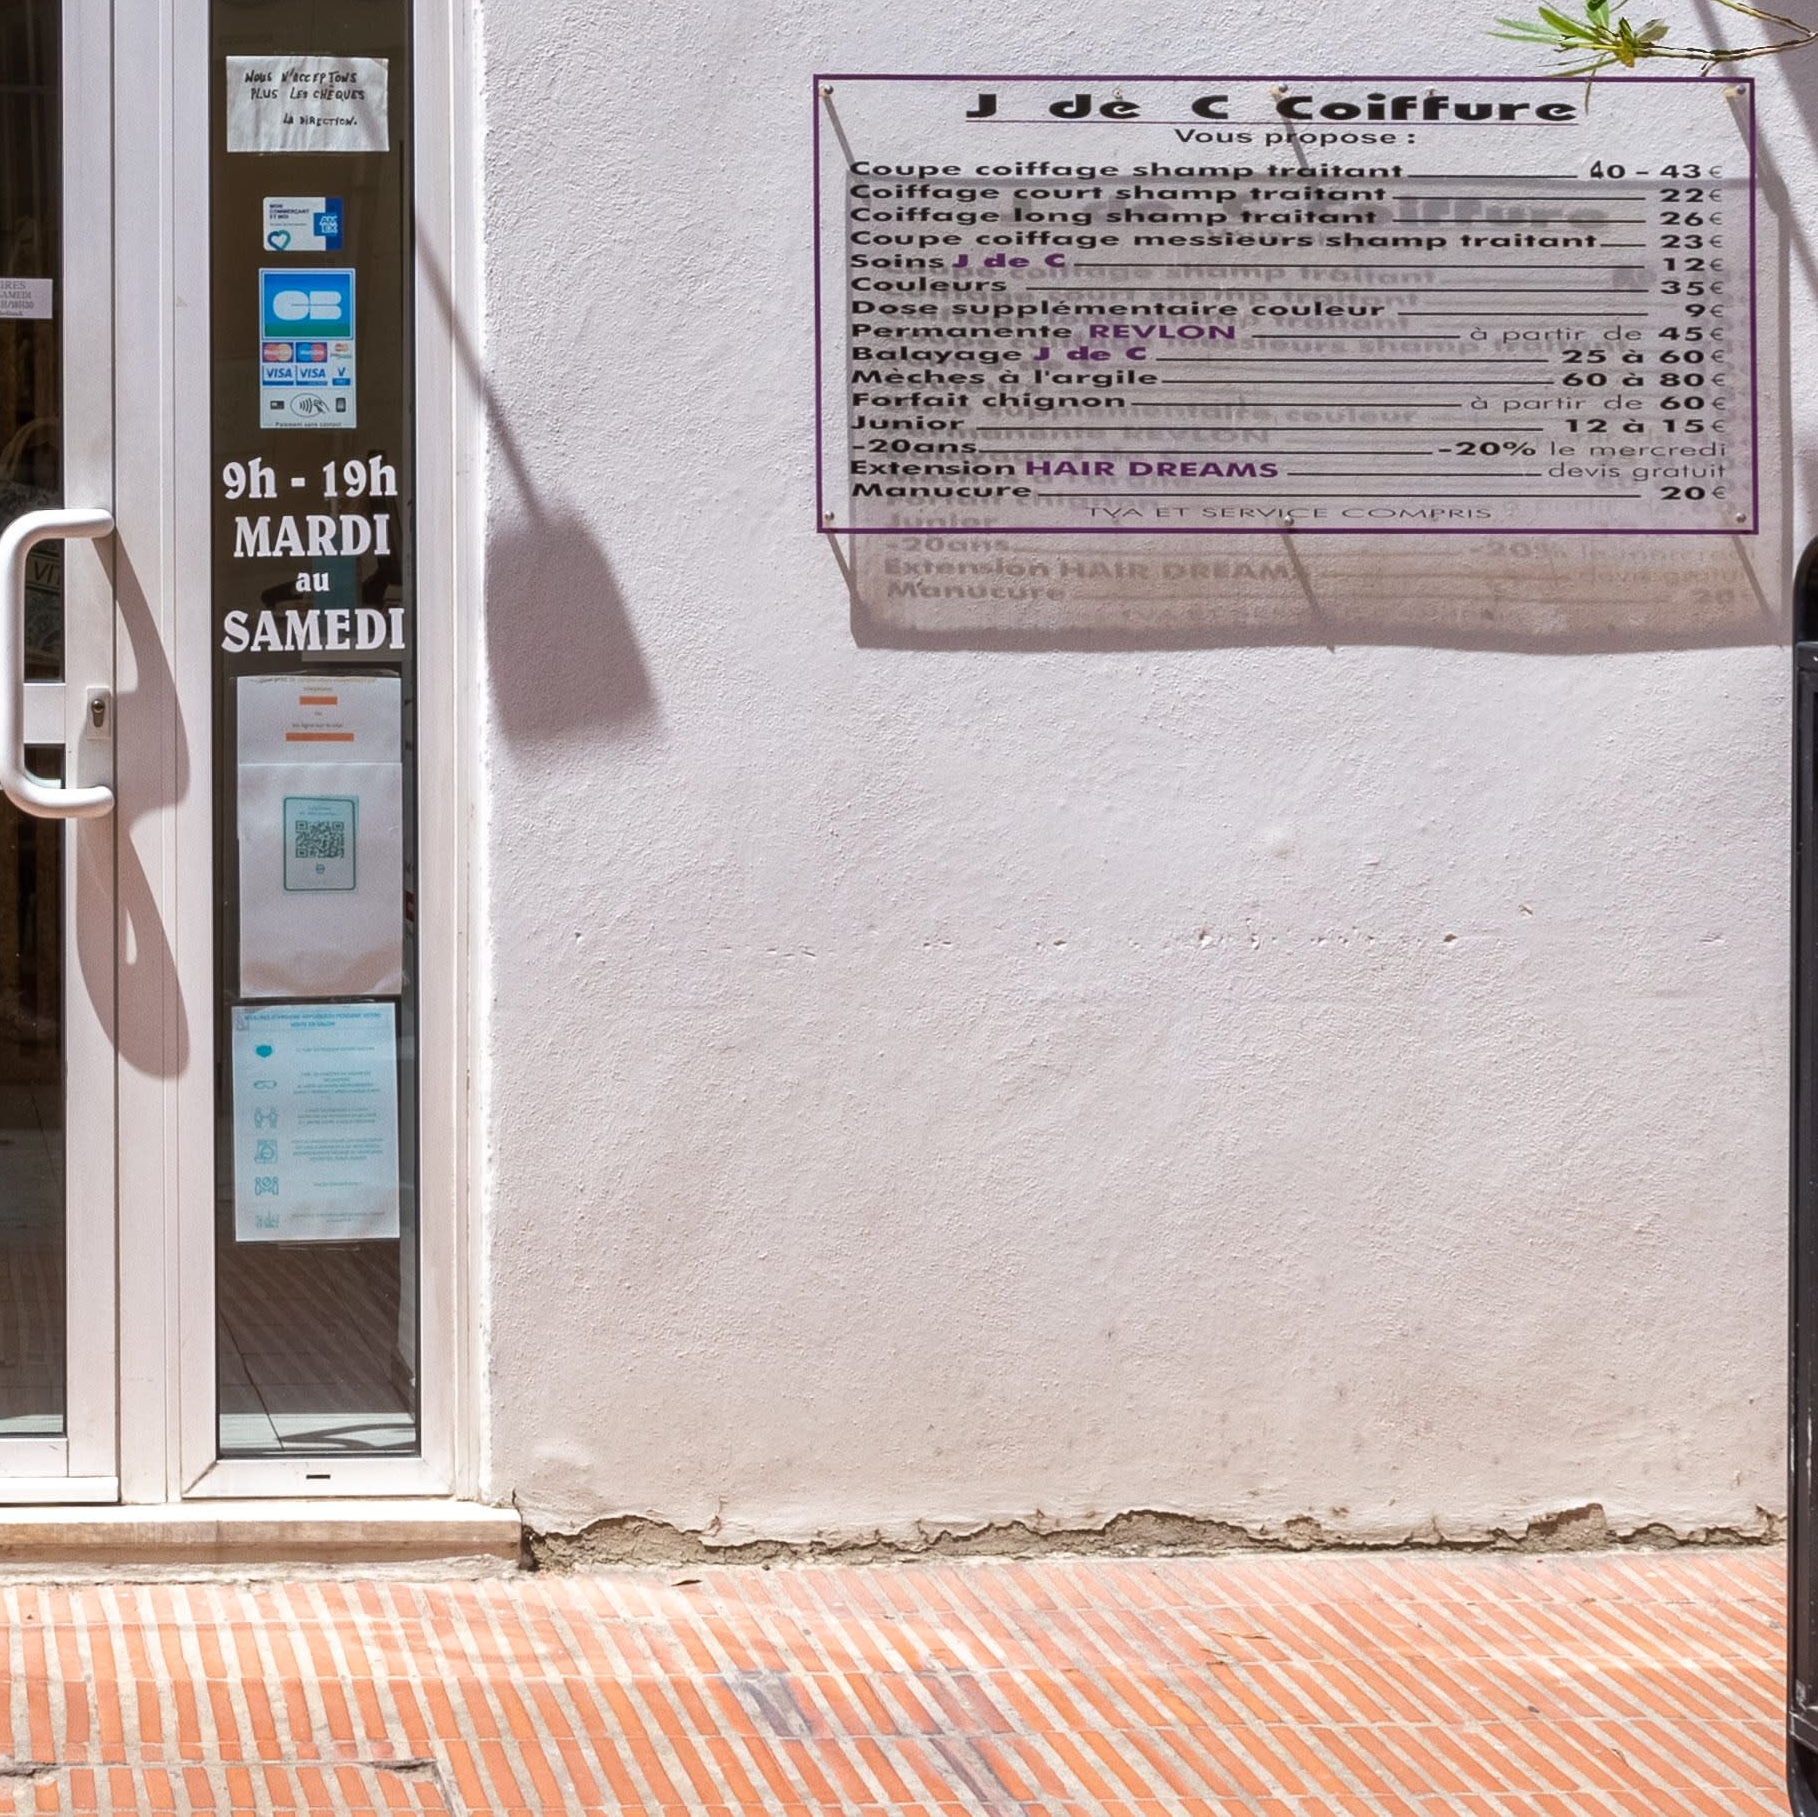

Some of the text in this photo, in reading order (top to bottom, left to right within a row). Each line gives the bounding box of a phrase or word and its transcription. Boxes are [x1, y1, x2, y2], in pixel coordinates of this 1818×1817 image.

[966, 93, 1577, 122] J de C Coiffure
[1175, 128, 1397, 147] Vous propose
[850, 161, 962, 179] Coupe
[975, 161, 1120, 180] coiffage
[1133, 162, 1254, 180] shamp
[1266, 164, 1404, 178] traitant
[1590, 160, 1626, 179] 40
[850, 184, 1000, 202] Coiffage
[1013, 186, 1102, 200] court
[1116, 185, 1237, 203] shamp
[1249, 187, 1386, 201] traitant
[850, 207, 1000, 225] Coiffage
[1015, 208, 1093, 226] long
[1106, 208, 1228, 226] shamp
[1240, 209, 1377, 224] traitant
[850, 231, 962, 249] Coupe
[976, 231, 1120, 249] coiffage
[1134, 232, 1314, 247] messieurs
[1325, 233, 1447, 251] shamp
[1461, 233, 1597, 248] traitant
[850, 254, 945, 269] Soins
[953, 254, 969, 268] J
[983, 254, 1030, 268] de
[1044, 254, 1066, 268] C
[850, 277, 1007, 292] Couleurs
[851, 300, 939, 315] Dose
[952, 300, 1238, 318] supplémentaire
[1251, 301, 1385, 317] couleur
[852, 323, 1073, 338] Permanente
[1088, 324, 1236, 340] REVLON
[1470, 326, 1488, 341] à
[1502, 327, 1585, 344] partir
[1603, 325, 1643, 341] de
[852, 346, 1022, 364] Balayage
[1033, 346, 1050, 362] J
[1066, 346, 1111, 362] de
[1126, 346, 1146, 362] C
[1561, 350, 1607, 364] 25
[1621, 348, 1644, 364] à
[266, 367, 293, 379] VISA
[299, 367, 327, 379] VISA
[852, 368, 985, 385] Mèches
[998, 369, 1019, 385] à
[1034, 368, 1159, 388] l'argile
[1561, 373, 1608, 387] 60
[1621, 371, 1644, 387] à
[852, 392, 969, 408] Forfait
[982, 392, 1126, 411] chignon
[1470, 395, 1488, 410] à
[1503, 396, 1586, 413] partir
[1603, 395, 1643, 410] de
[850, 416, 965, 431] Junior
[1565, 419, 1608, 433] 12
[1622, 417, 1645, 434] à
[1438, 441, 1537, 457] -20%
[1550, 441, 1575, 457] le
[1589, 441, 1727, 458] mercredi
[222, 454, 398, 500] 9h 19h
[850, 460, 1727, 482] Extension HAIR DREAMS devis gratuit
[852, 483, 1033, 498] Manucure
[1087, 507, 1492, 520] TVA ET SERVICE COMPRIS
[233, 513, 391, 558] MARDI
[295, 571, 330, 593] au
[221, 607, 405, 653] SAMEDI
